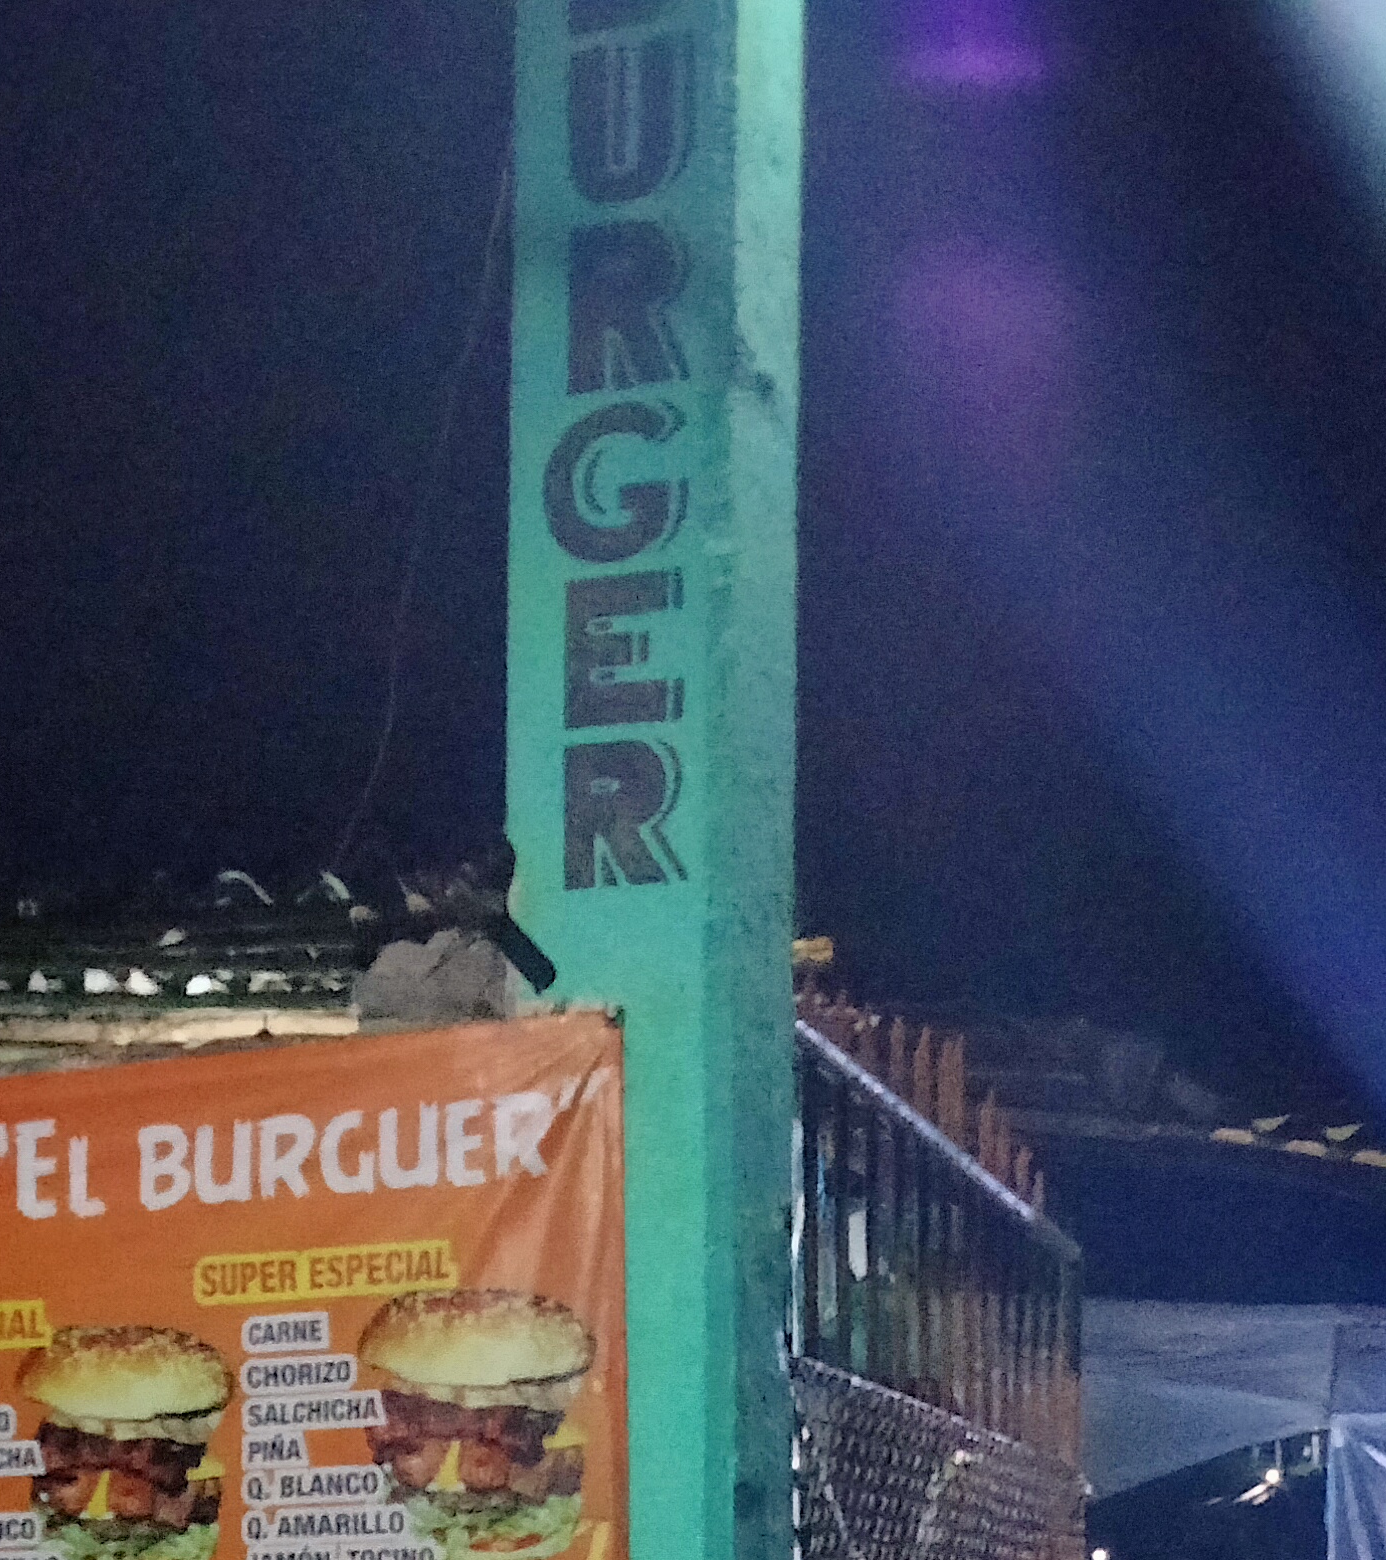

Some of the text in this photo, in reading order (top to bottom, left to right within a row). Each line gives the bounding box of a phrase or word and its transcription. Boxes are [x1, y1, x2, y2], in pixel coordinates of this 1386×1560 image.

[542, 0, 692, 892] URGER
[199, 1246, 452, 1298] SUPER ESPECIAL
[247, 1318, 323, 1346] CARNE
[246, 1360, 352, 1390] CHORIZO
[247, 1397, 380, 1428] SALCHICHA
[248, 1432, 303, 1464] PIÑA
[246, 1470, 380, 1501] Q. BLANCO
[246, 1509, 406, 1541] Q. AMARILLO
